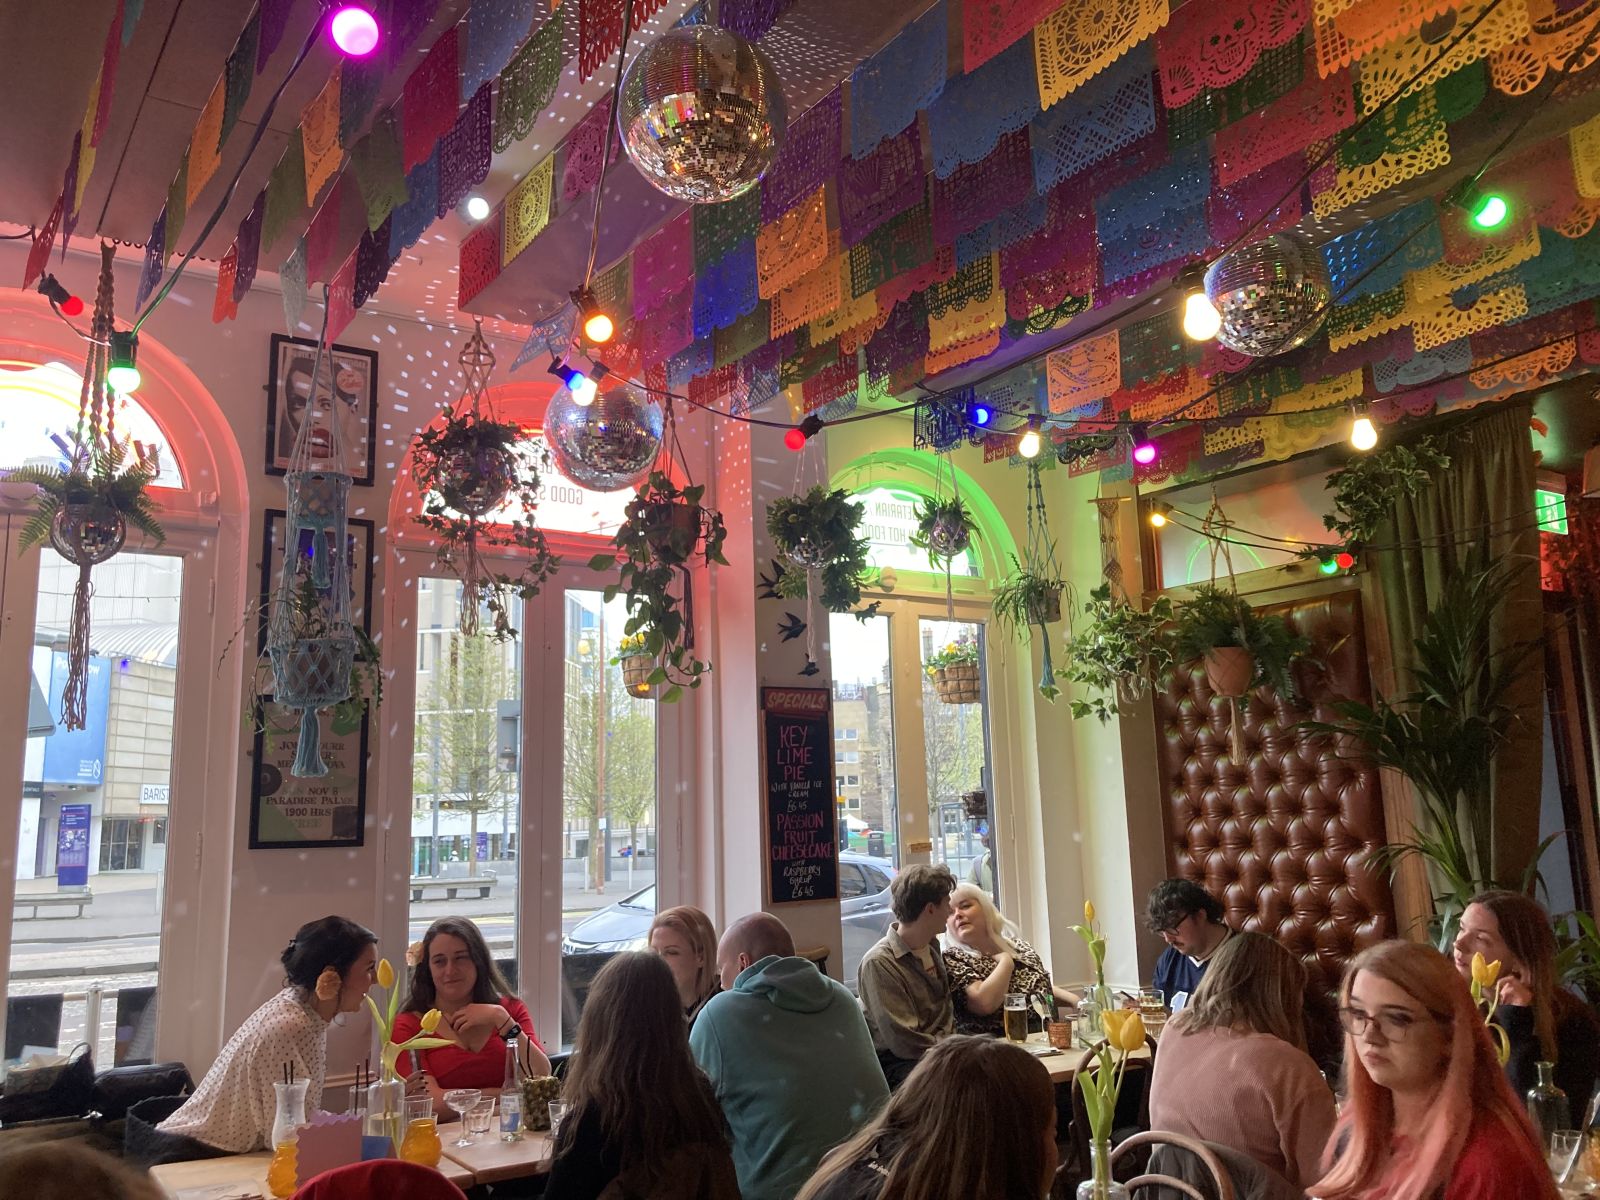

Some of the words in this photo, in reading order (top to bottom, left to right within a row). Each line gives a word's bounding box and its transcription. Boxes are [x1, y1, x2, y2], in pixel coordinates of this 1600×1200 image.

[767, 692, 827, 709] SPECIALS
[780, 725, 808, 748] KEY
[777, 747, 813, 765] LIME
[784, 765, 806, 781] PIE
[143, 787, 169, 801] BARIST
[308, 787, 329, 796] NOV
[266, 796, 317, 805] PARADISE
[285, 808, 308, 817] 1900
[310, 808, 332, 817] HRS
[776, 811, 824, 831] PASSION
[784, 830, 818, 846] FRUIT
[772, 841, 833, 861] CHEESECAKE
[783, 864, 821, 877] RASPBERRY
